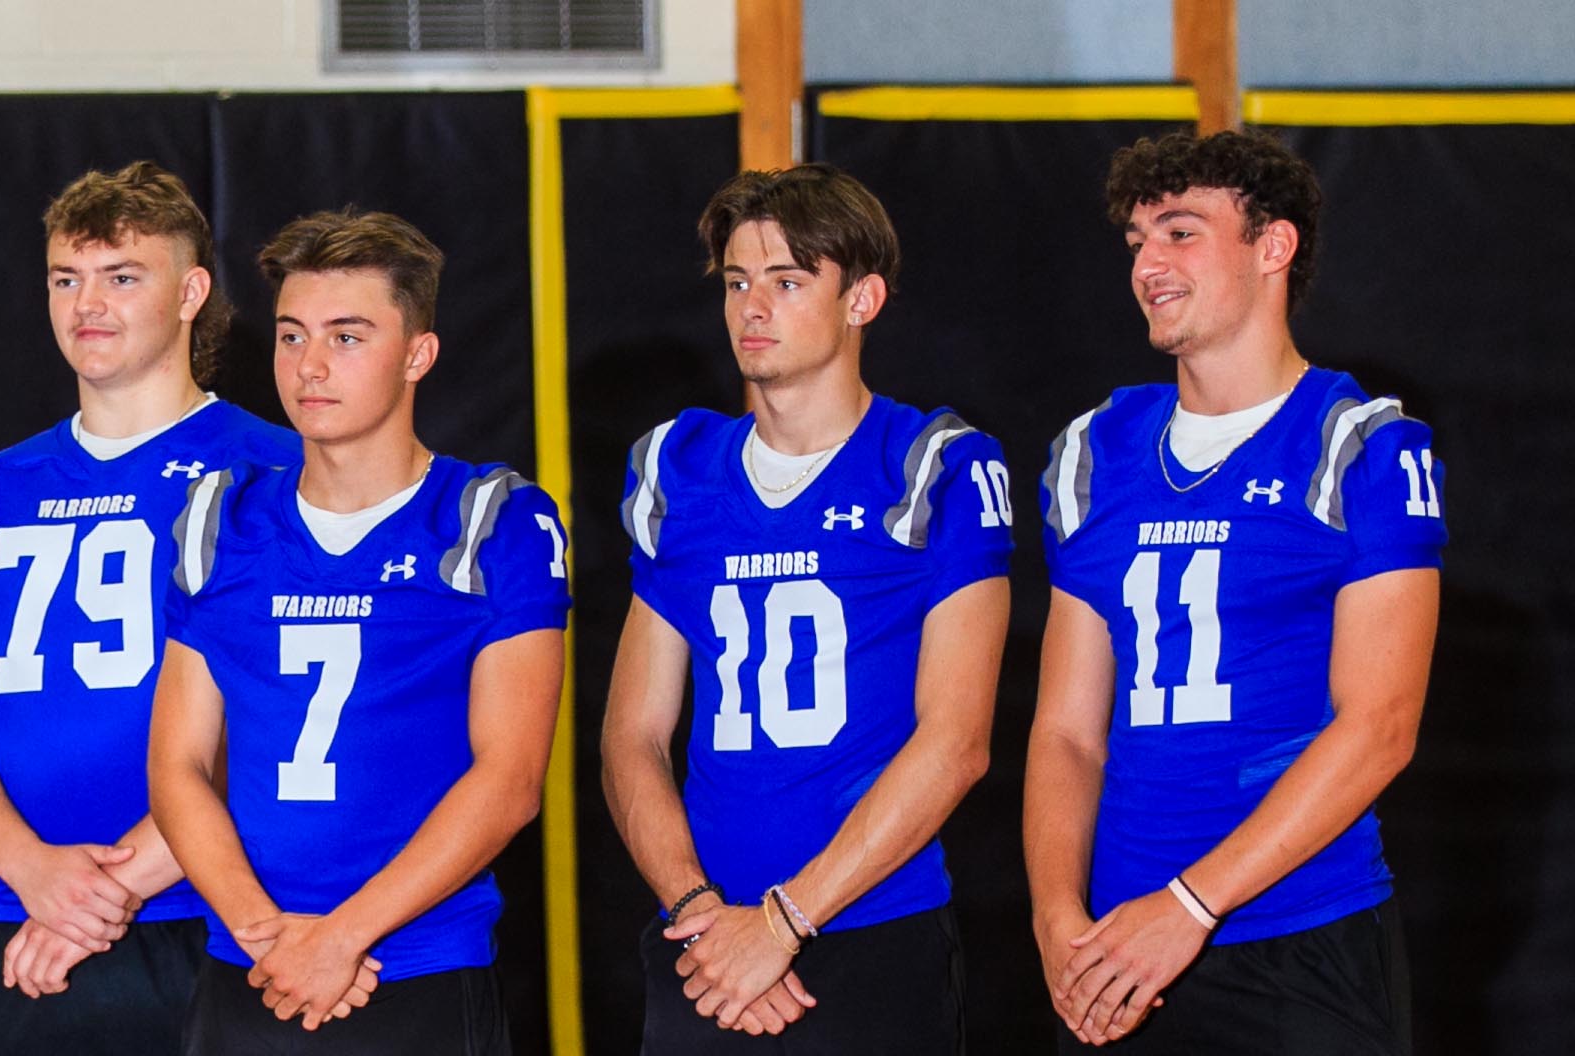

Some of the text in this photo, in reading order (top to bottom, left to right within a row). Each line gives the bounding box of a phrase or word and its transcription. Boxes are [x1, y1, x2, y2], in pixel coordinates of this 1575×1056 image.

[38, 494, 135, 519] WARRIORS
[970, 460, 1012, 527] 10
[1400, 449, 1440, 518] 11
[534, 513, 566, 579] 7
[725, 551, 819, 579] WARRIORS
[1138, 520, 1231, 546] WARRIORS
[272, 595, 373, 618] WARRIORS
[1123, 549, 1232, 727] 11
[710, 579, 847, 751] 10
[278, 624, 362, 801] 7
